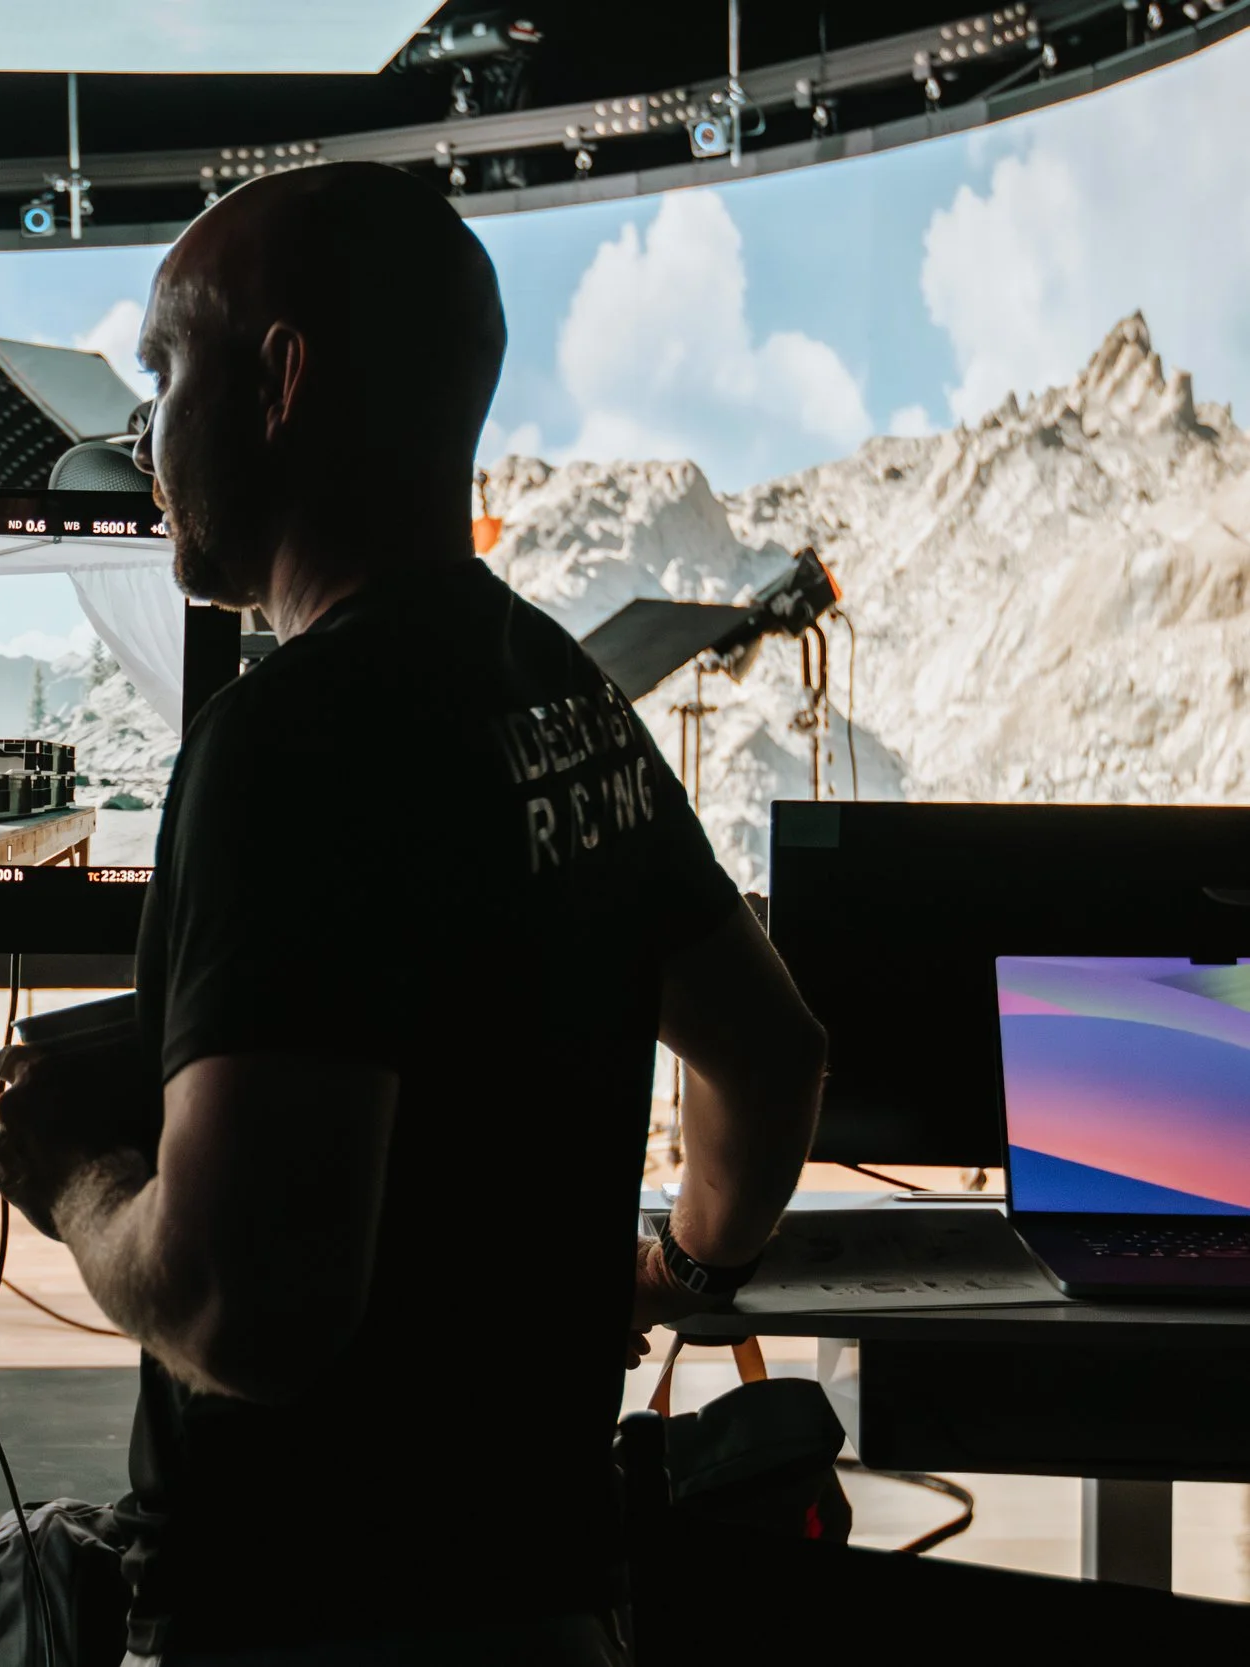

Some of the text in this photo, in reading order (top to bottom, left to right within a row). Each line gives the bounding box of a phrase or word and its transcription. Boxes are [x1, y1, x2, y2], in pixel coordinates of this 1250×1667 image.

[8, 520, 46, 533] ND 0.6
[64, 521, 137, 535] WB 5600 K
[14, 869, 24, 882] h
[87, 872, 100, 882] TC
